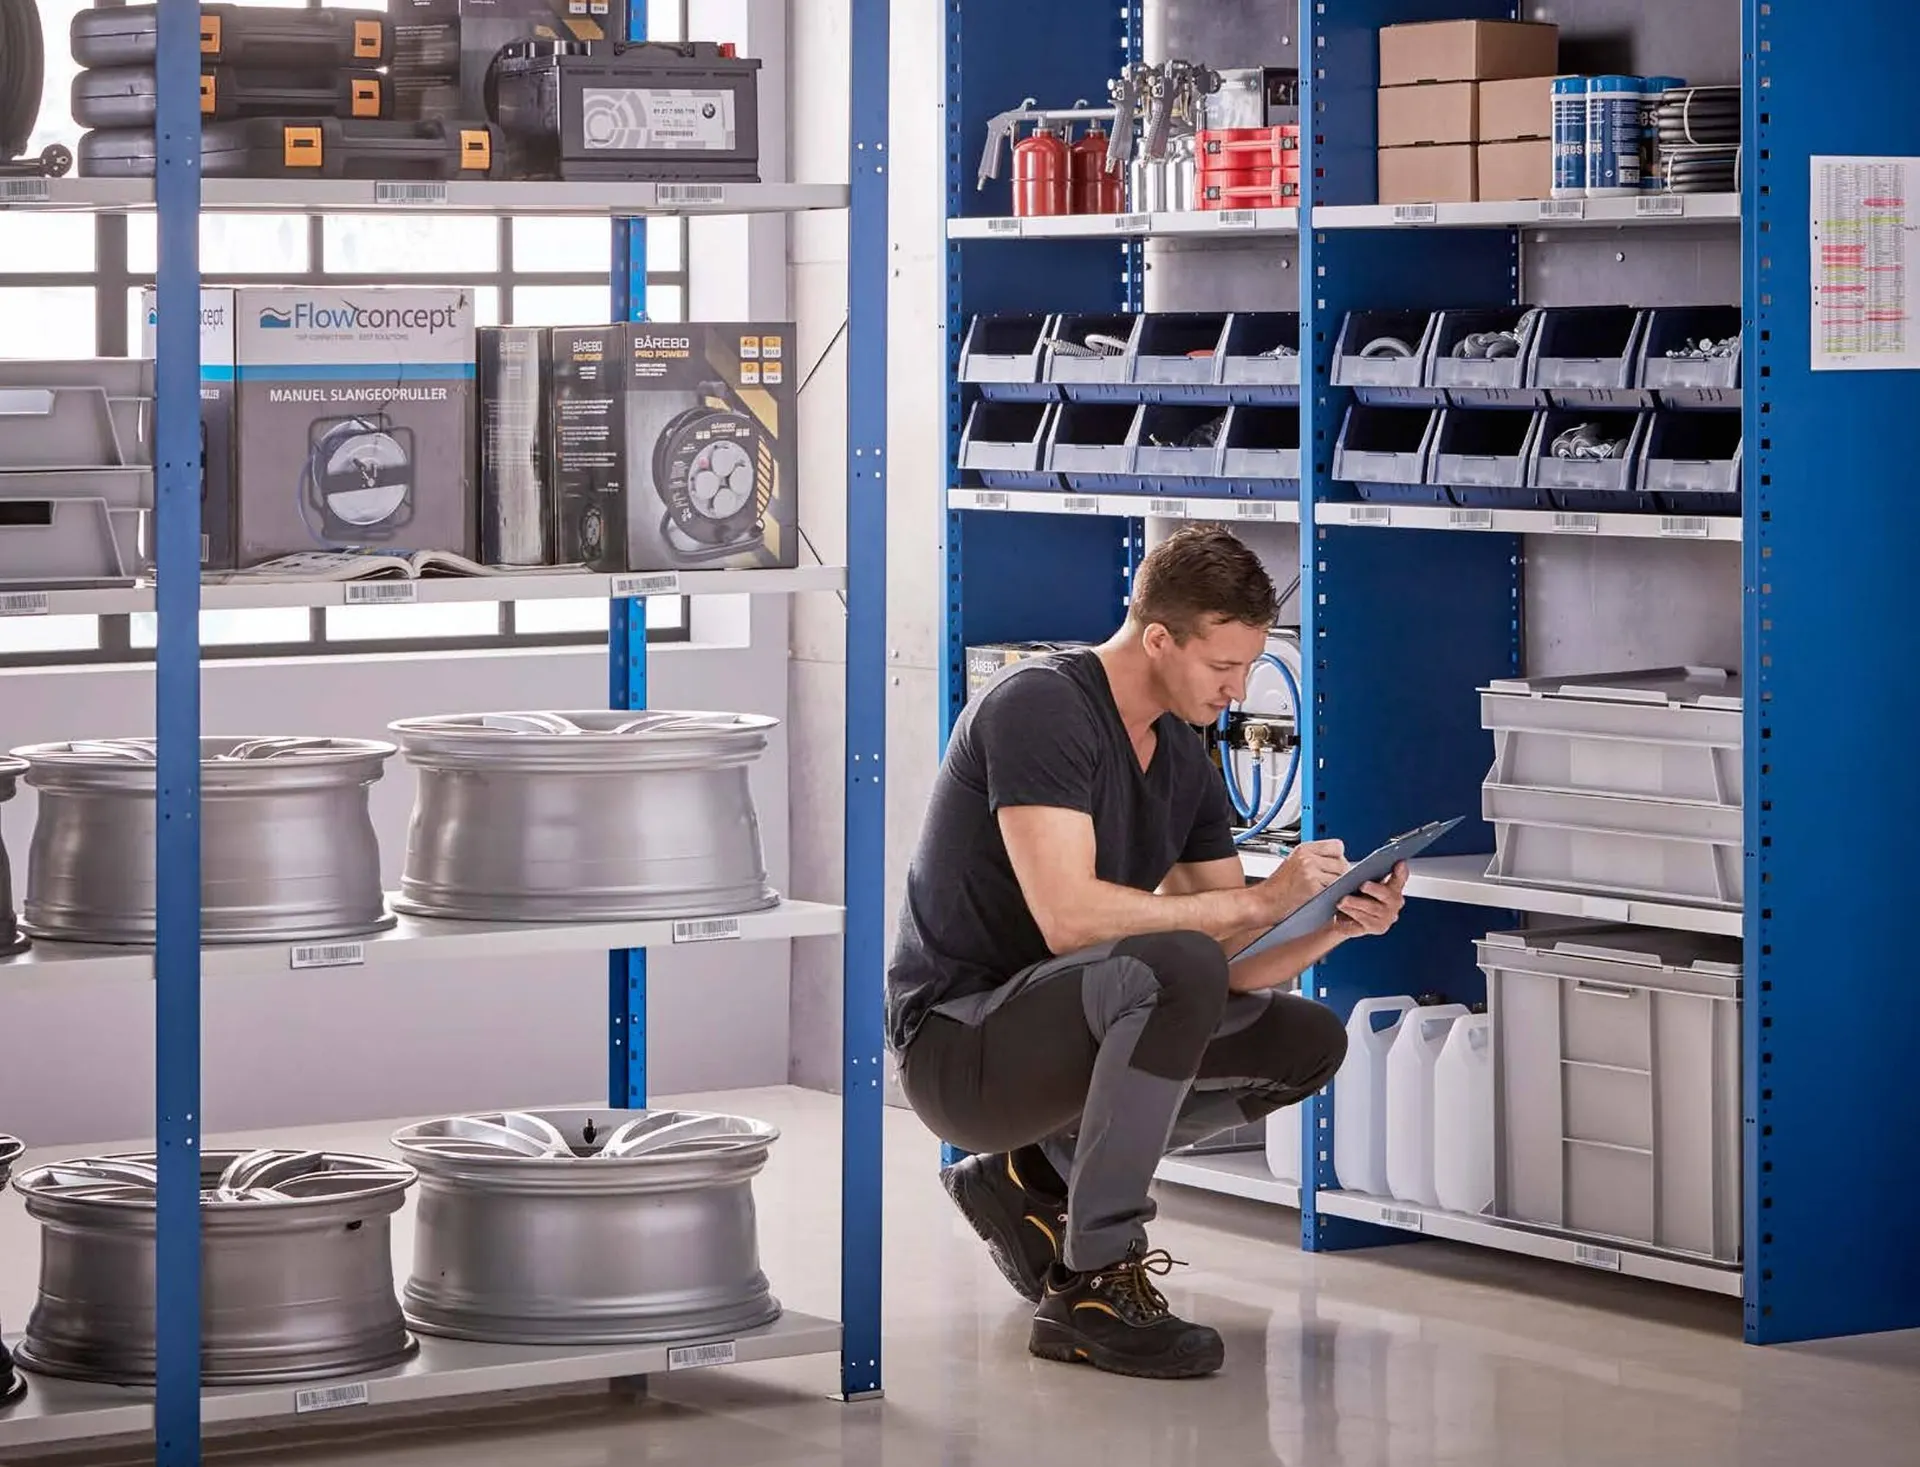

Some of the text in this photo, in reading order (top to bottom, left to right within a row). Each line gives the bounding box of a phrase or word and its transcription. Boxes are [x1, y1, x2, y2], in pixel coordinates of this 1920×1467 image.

[294, 300, 457, 335] Flowconcept
[573, 339, 603, 353] BÅREBO
[634, 334, 690, 349] BÅREBO
[635, 349, 690, 358] PRO POWER
[269, 387, 448, 402] MANUEL SLANGEOPRULLER
